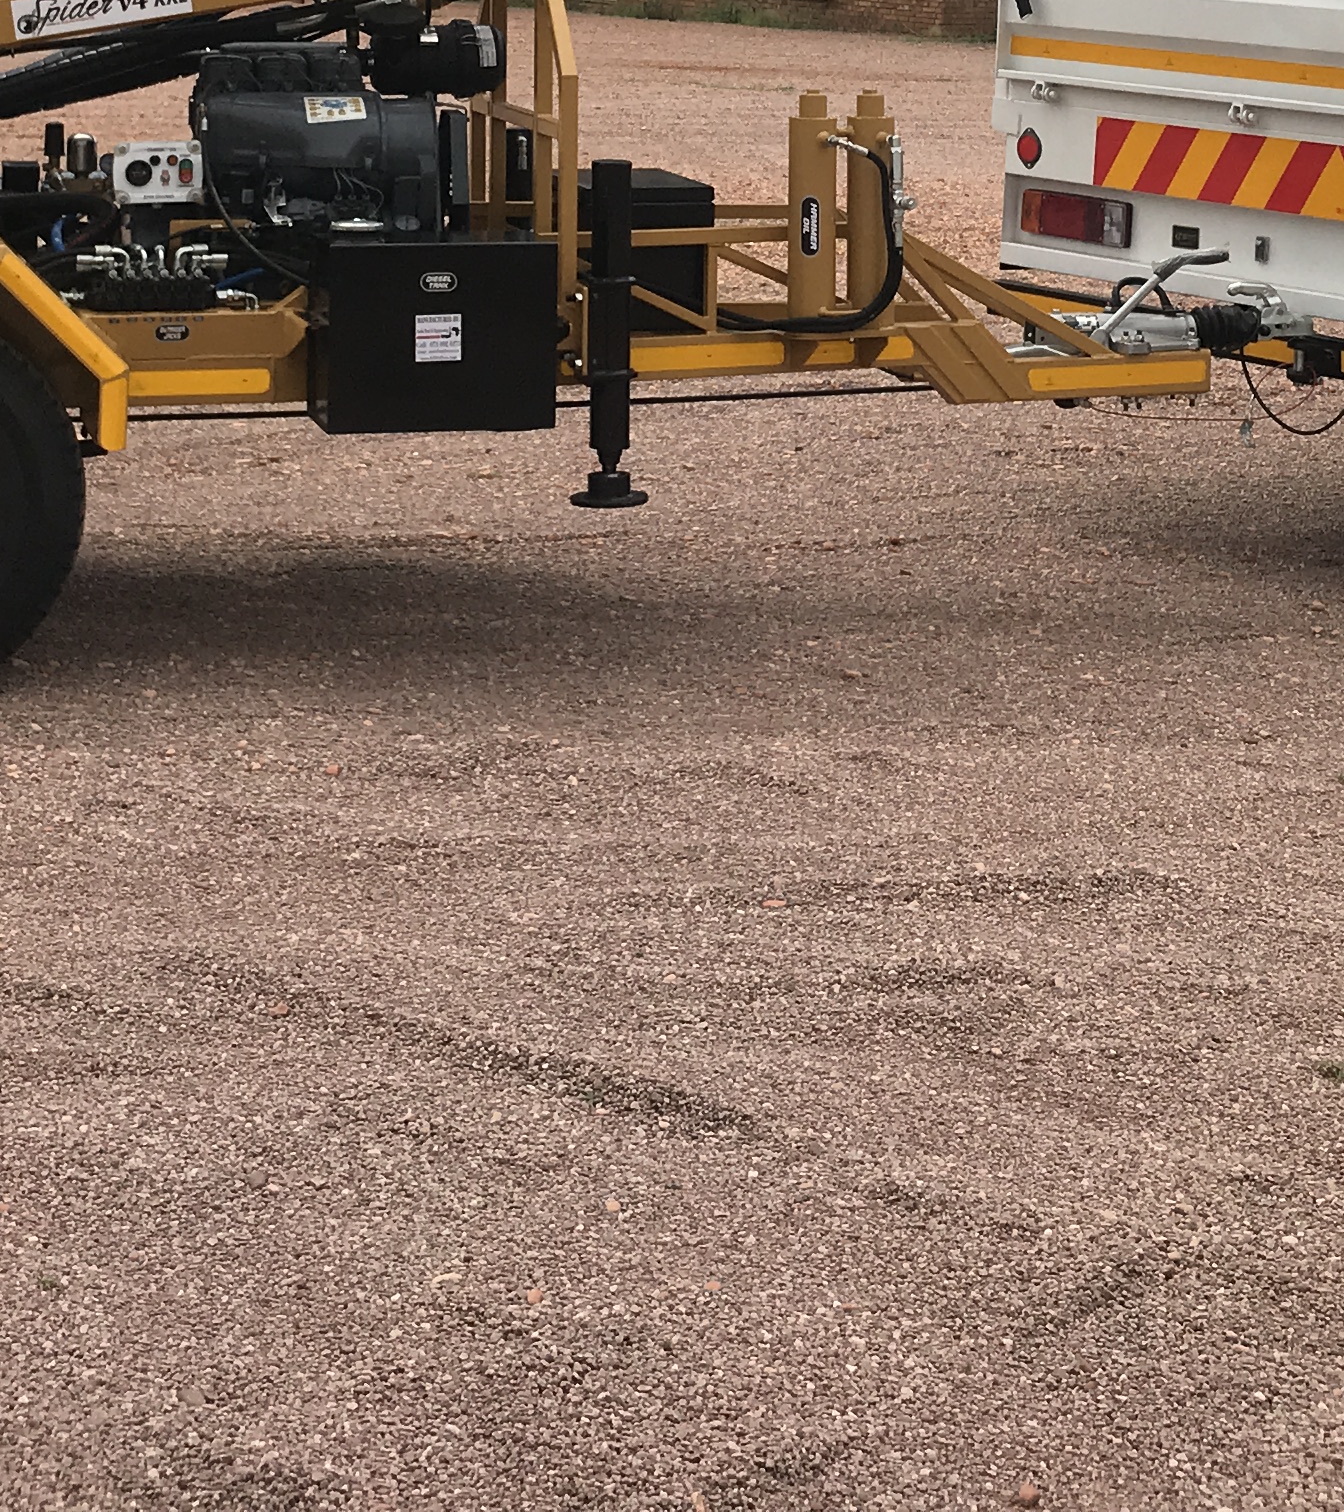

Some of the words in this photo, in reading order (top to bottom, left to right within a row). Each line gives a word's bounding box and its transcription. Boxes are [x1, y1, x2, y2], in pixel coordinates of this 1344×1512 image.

[802, 217, 810, 234] OIL
[810, 202, 818, 250] HAMMER
[425, 275, 452, 283] DIESEL
